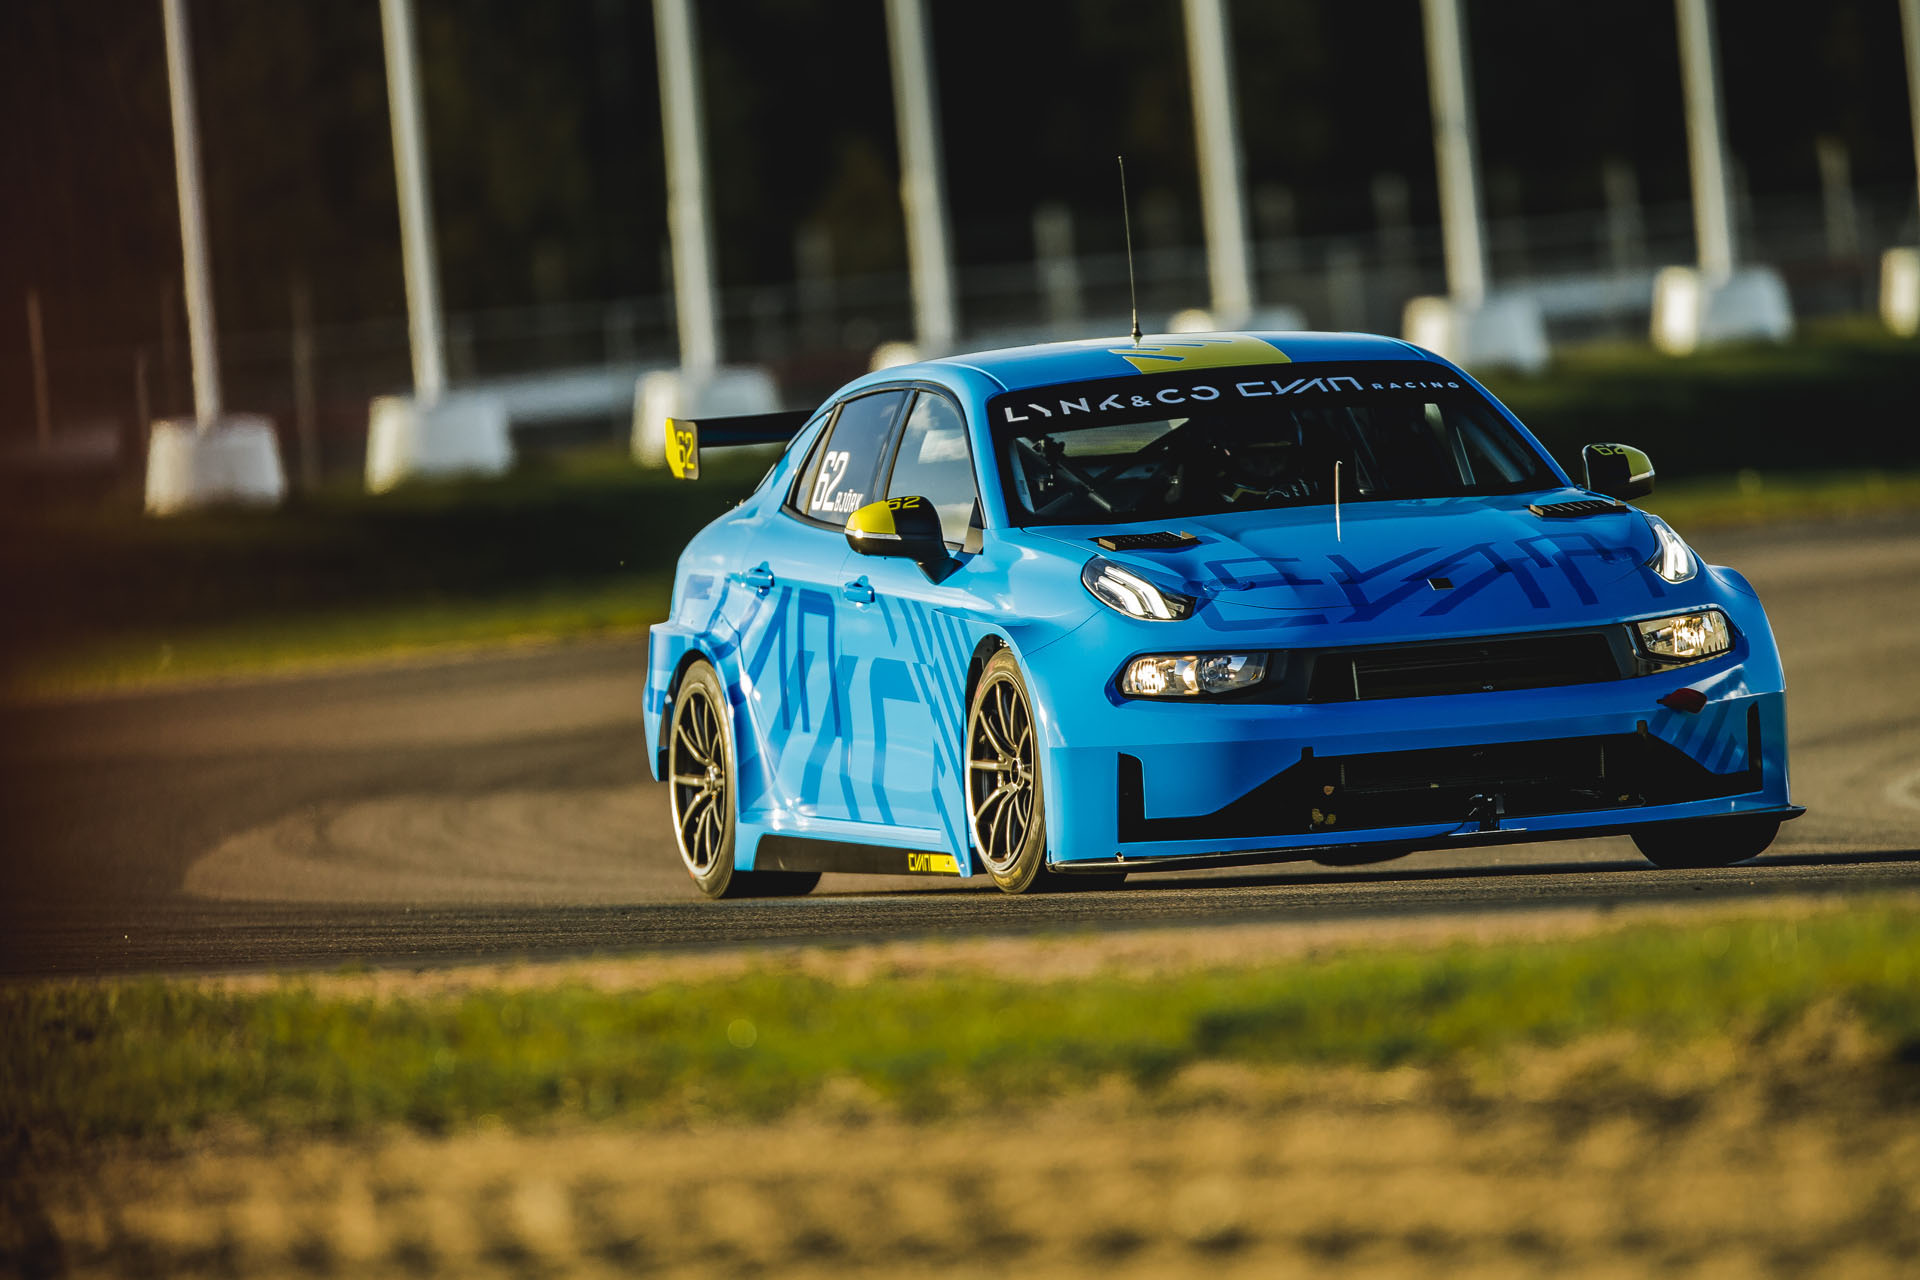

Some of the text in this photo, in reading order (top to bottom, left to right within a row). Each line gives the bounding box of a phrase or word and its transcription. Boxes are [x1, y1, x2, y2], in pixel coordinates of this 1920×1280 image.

[1235, 376, 1365, 398] CYAN
[1371, 380, 1460, 391] RACING
[676, 430, 696, 470] 62
[811, 451, 850, 512] 62
[886, 496, 921, 511] 62
